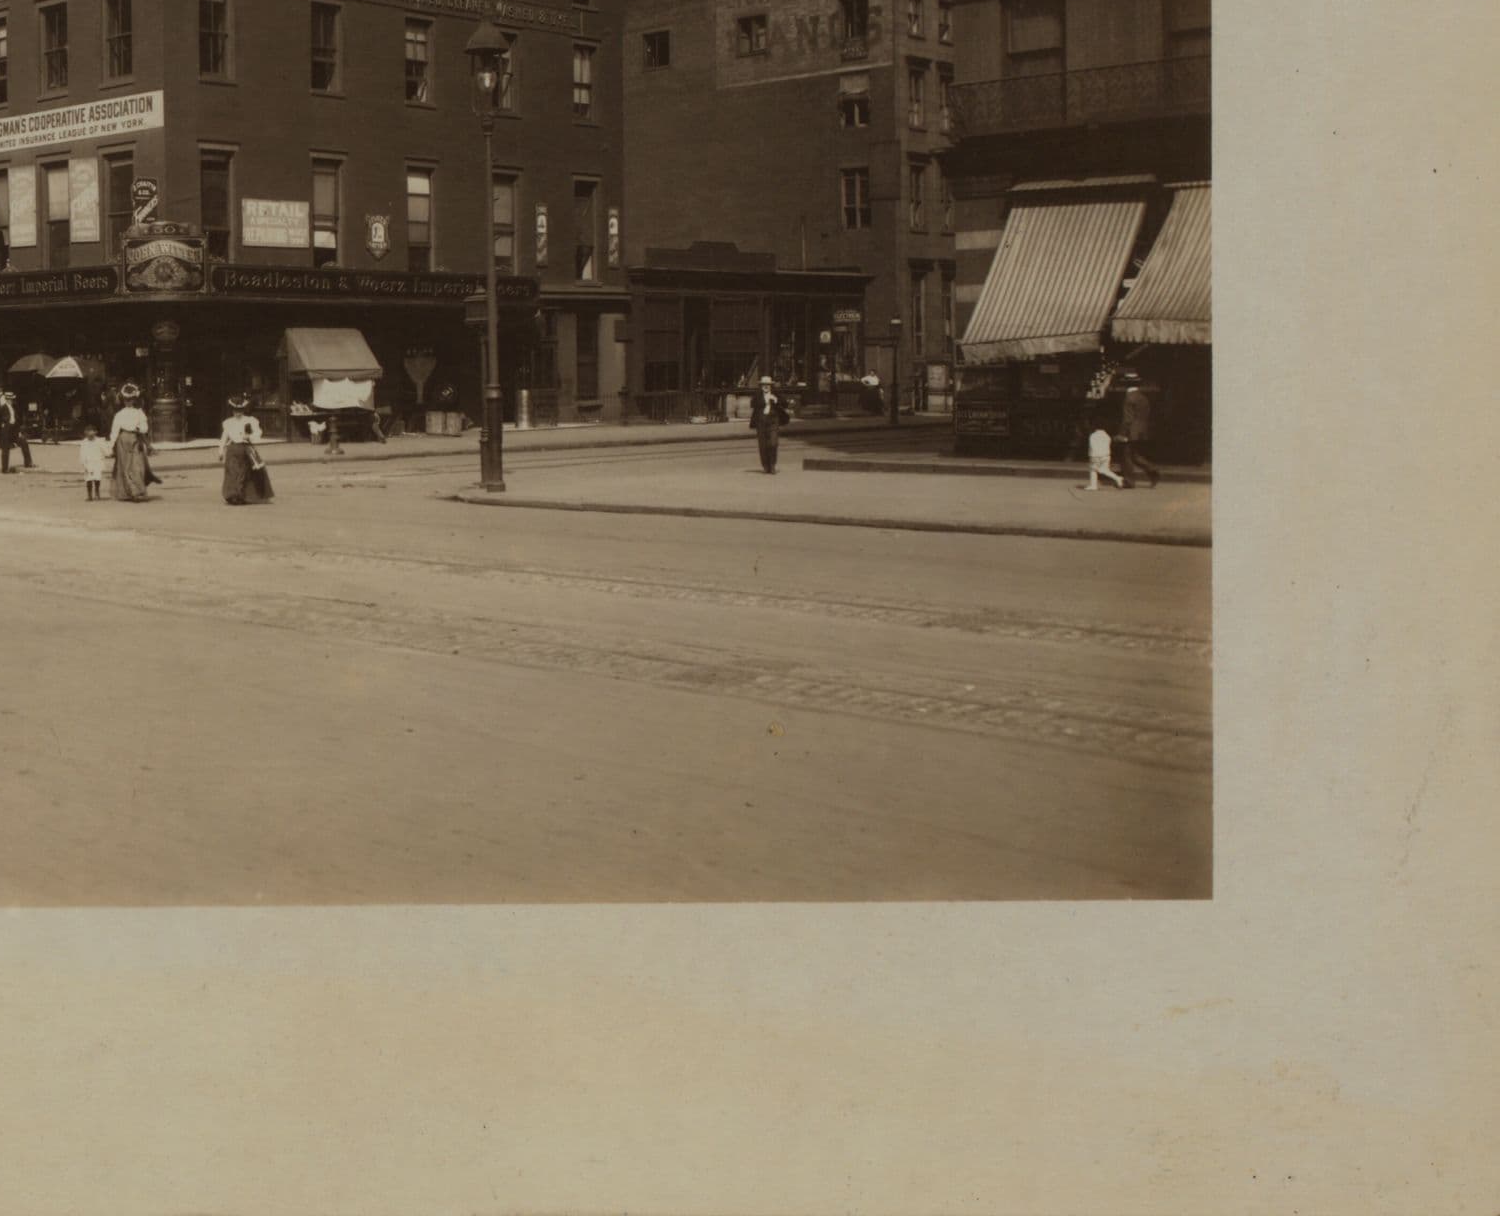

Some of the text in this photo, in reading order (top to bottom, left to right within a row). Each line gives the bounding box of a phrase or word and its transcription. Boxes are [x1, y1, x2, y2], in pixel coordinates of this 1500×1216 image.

[28, 107, 86, 132] COOPERATIVE
[88, 95, 154, 122] ASSOCIATION
[19, 134, 56, 146] INSURANCE
[58, 129, 87, 140] LEAGUE
[89, 126, 99, 135] OF
[101, 123, 118, 133] NEW
[246, 200, 305, 217] RETAIL
[20, 274, 69, 296] Imperial
[74, 273, 110, 290] Beers
